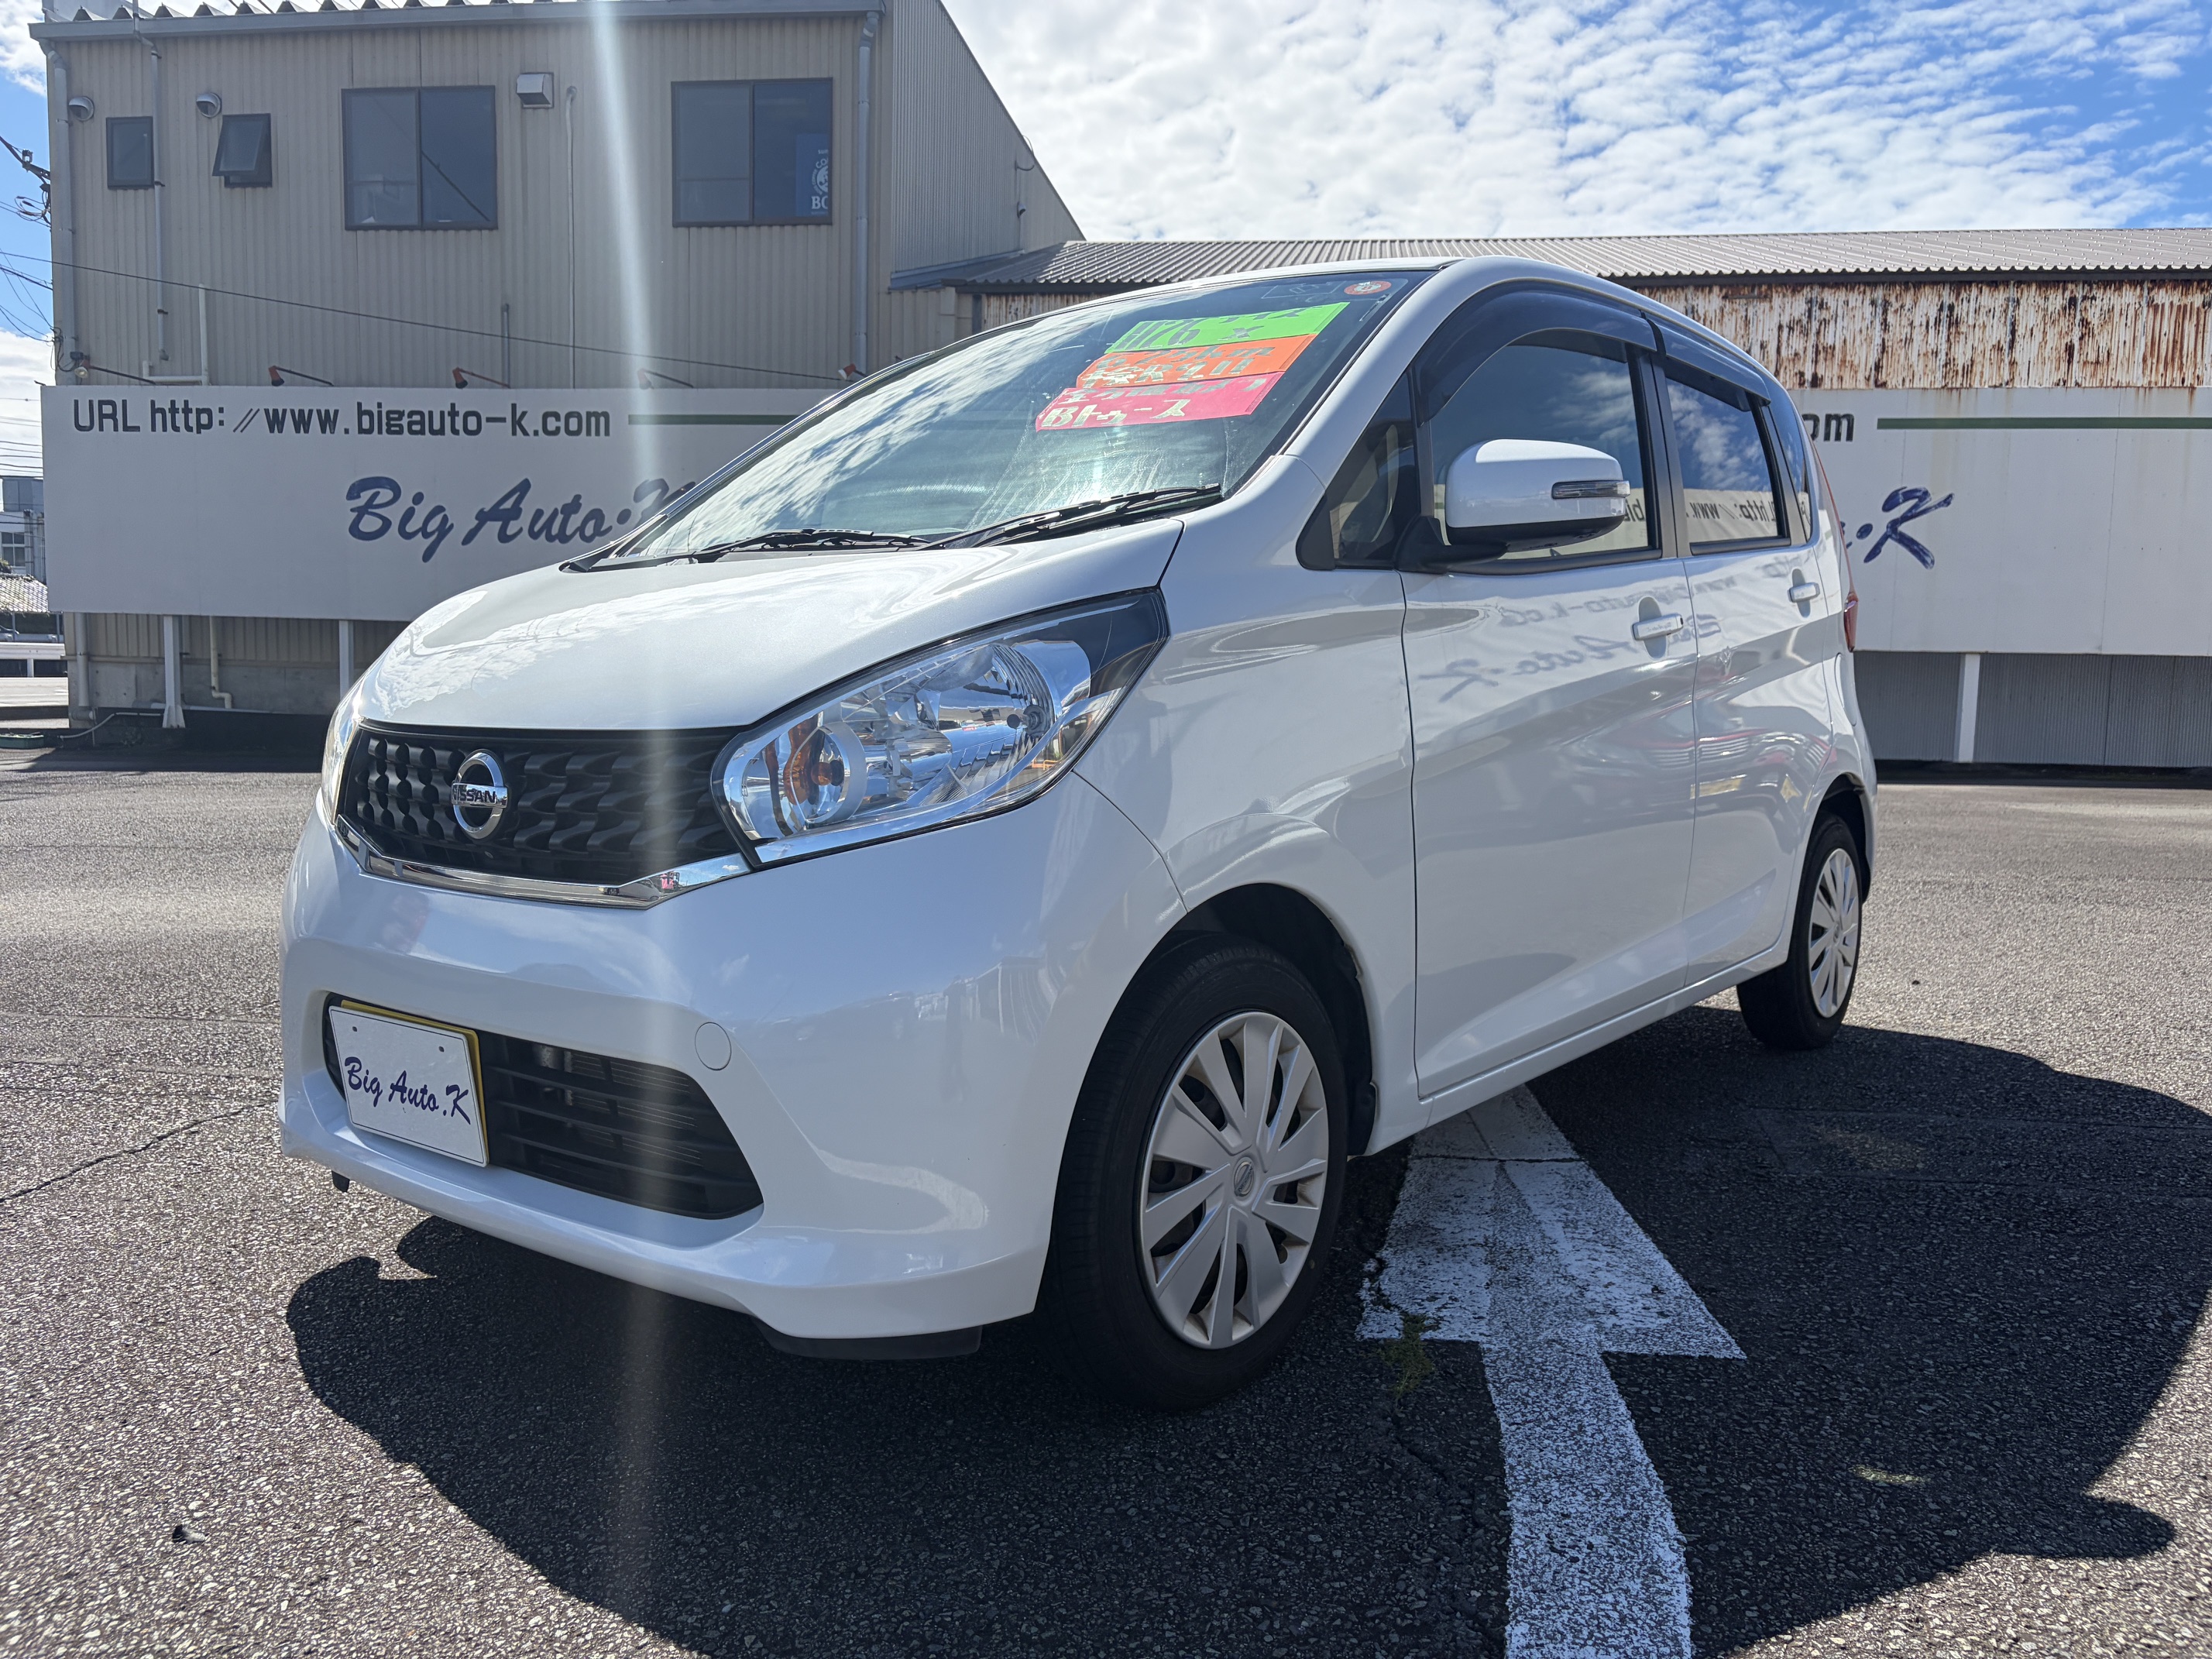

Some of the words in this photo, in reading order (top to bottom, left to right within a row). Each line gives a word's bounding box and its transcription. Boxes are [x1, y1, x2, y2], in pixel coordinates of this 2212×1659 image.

[816, 157, 829, 169] CO
[1115, 318, 1205, 352] H26
[73, 399, 141, 432] URL
[345, 476, 455, 564] Big
[452, 784, 498, 804] NISSAN
[345, 1056, 383, 1108] Big
